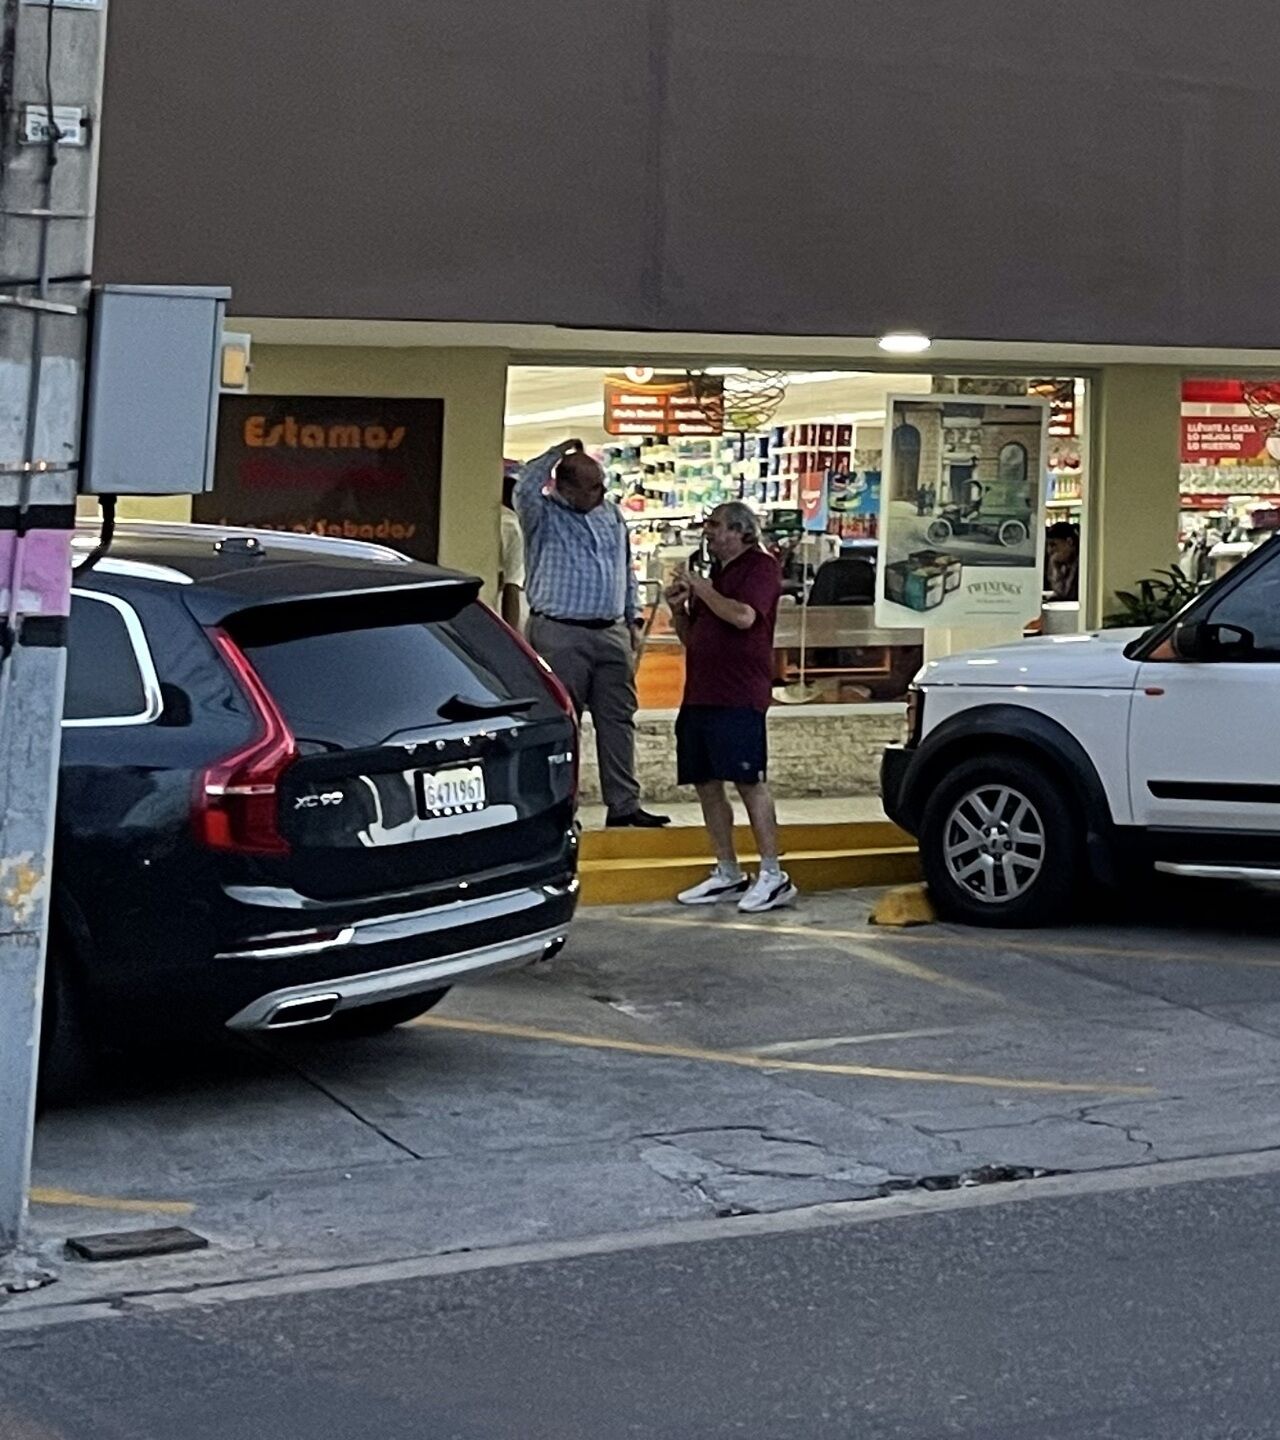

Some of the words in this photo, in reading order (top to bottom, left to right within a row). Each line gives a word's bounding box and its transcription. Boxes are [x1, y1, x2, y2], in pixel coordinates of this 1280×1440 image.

[244, 415, 406, 448] Estamos
[294, 790, 343, 810] XC90
[426, 777, 483, 804] G471967
